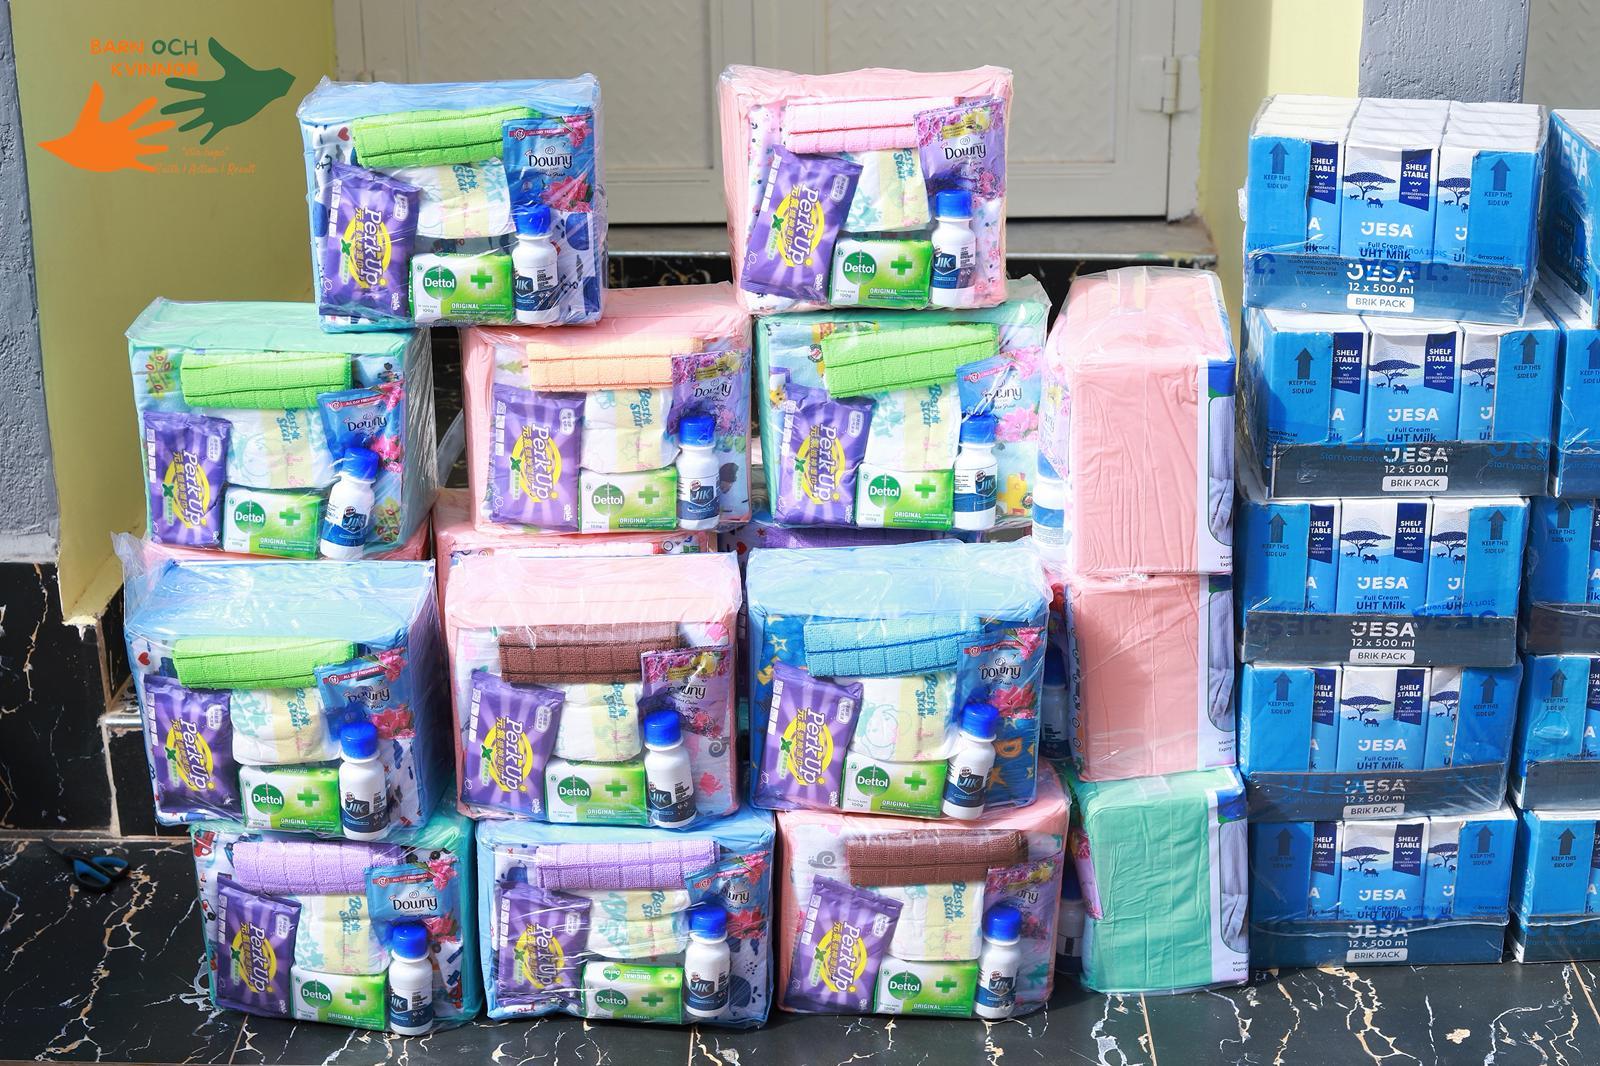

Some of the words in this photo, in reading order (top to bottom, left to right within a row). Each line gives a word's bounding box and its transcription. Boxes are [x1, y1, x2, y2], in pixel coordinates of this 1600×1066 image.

[945, 143, 986, 159] Downy
[529, 155, 572, 169] Downy
[1405, 163, 1427, 171] SHELF
[1403, 170, 1429, 179] STABLE
[788, 184, 818, 265] PerkUp
[1361, 221, 1413, 238] JESA
[365, 207, 383, 286] PerkUp
[1360, 249, 1382, 258] UHT
[1387, 250, 1411, 260] Milk
[935, 257, 951, 268] JIK
[844, 263, 875, 274] Dettol
[1347, 263, 1414, 284] JESA
[425, 278, 455, 288] Dettol
[1349, 283, 1360, 291] 12
[1373, 284, 1396, 294] 500
[1400, 286, 1414, 294] ml
[1355, 298, 1377, 306] BRIK
[1380, 299, 1406, 308] PACK
[1388, 408, 1439, 421] JESA
[347, 416, 388, 432] Downy
[1387, 434, 1409, 442] UHT
[1413, 434, 1436, 442] Milk
[1384, 447, 1448, 463] JESA
[532, 424, 553, 499] PerkUp
[813, 424, 837, 501] PerkUp
[1385, 465, 1394, 473] 12
[1409, 465, 1431, 473] 500
[1434, 465, 1448, 473] ml
[184, 450, 201, 526] PerkUp
[1391, 479, 1412, 487] BRIK
[1414, 479, 1440, 487] PACK
[692, 489, 710, 500] JIK
[869, 486, 900, 497] Dettol
[593, 495, 623, 505] Dettol
[235, 511, 265, 524] Dettol
[1357, 577, 1409, 590] JESA
[1356, 601, 1378, 610] UHT
[1382, 601, 1406, 610] Milk
[1351, 622, 1416, 638] JESA
[1376, 639, 1398, 647] 500
[1401, 639, 1415, 647] ml
[1381, 652, 1406, 660] PACK
[981, 666, 1022, 680] Downy
[915, 690, 926, 718] Star
[799, 708, 826, 784] PerkUp
[1358, 739, 1407, 751] JESA
[181, 719, 209, 789] PerkUp
[503, 717, 523, 790] PerkUp
[1356, 762, 1378, 770] UHT
[1381, 761, 1404, 769] Milk
[857, 776, 888, 787] Dettol
[559, 787, 590, 797] Dettol
[253, 794, 283, 805] Dettol
[1368, 794, 1390, 802] 500
[345, 804, 365, 813] JIK
[1351, 807, 1371, 815] BRIK
[1372, 805, 1397, 814] PACK
[1359, 889, 1407, 901] JESA
[393, 897, 438, 911] Downy
[943, 896, 954, 922] Star
[1349, 925, 1408, 938] JESA
[1349, 940, 1358, 948] 12
[1371, 940, 1392, 948] 500
[1394, 939, 1408, 947] ml
[250, 923, 269, 992] PerkUp
[833, 922, 860, 992] PerkUp
[1354, 951, 1375, 959] BRIK
[1376, 951, 1400, 959] PACK
[691, 982, 711, 993] JIK
[889, 981, 920, 992] Dettol
[302, 988, 331, 1000] Dettol
[596, 995, 626, 1006] Dettol
